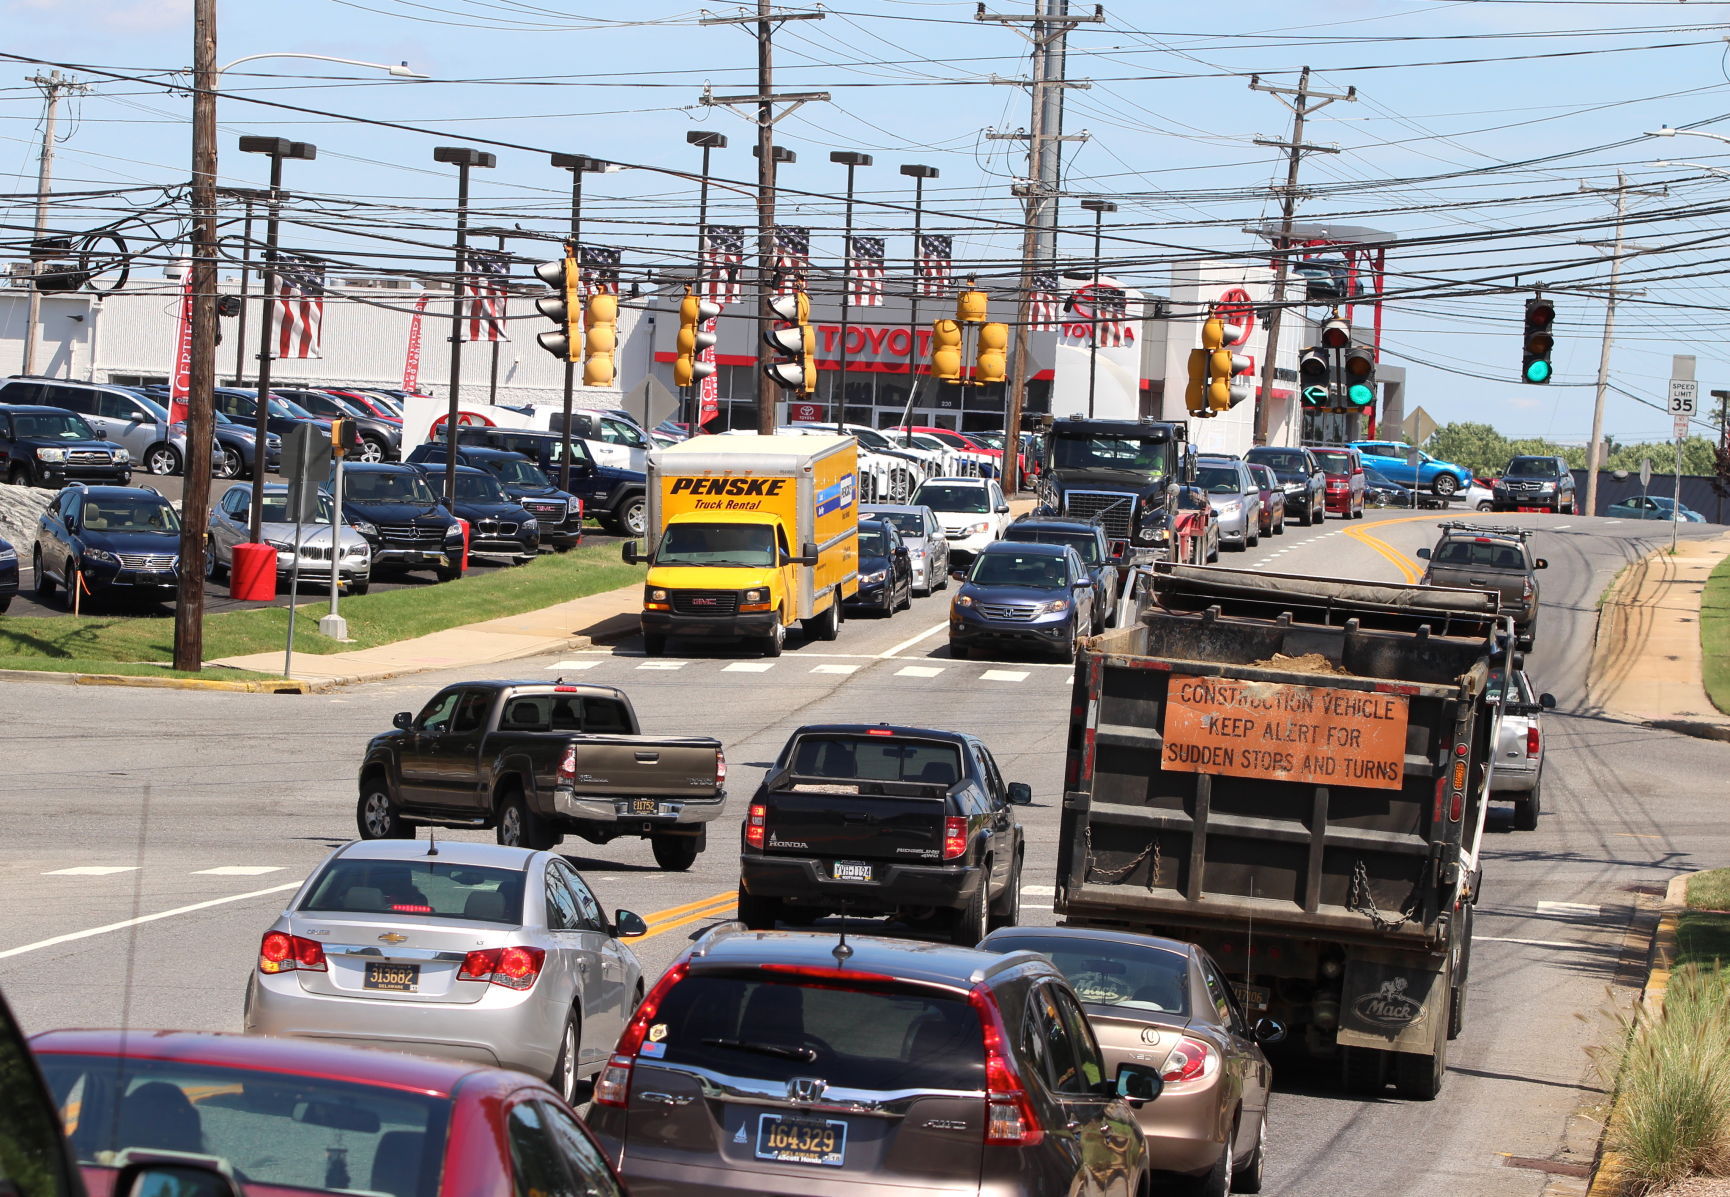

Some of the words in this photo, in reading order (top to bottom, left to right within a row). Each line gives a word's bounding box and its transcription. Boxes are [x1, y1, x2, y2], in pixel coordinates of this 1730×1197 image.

[818, 325, 934, 357] TOYOT
[1672, 398, 1693, 412] 35
[669, 478, 786, 496] PENSKE
[694, 499, 723, 510] Truck
[725, 500, 762, 510] Rental
[692, 598, 717, 606] GMC
[1180, 683, 1314, 714] CONSTRUCTION
[1322, 691, 1395, 721] VEHICLE
[1208, 716, 1255, 738] KEEP
[1262, 721, 1321, 744] ALERT
[1326, 726, 1362, 748] FOR
[1167, 742, 1235, 768] SUDDEN
[1240, 749, 1295, 773] STOPS
[1301, 754, 1337, 777] AND
[1343, 758, 1399, 781] TURNS
[370, 967, 414, 985] 313682
[1366, 1001, 1412, 1018] Mack
[767, 1123, 835, 1153] 164329
